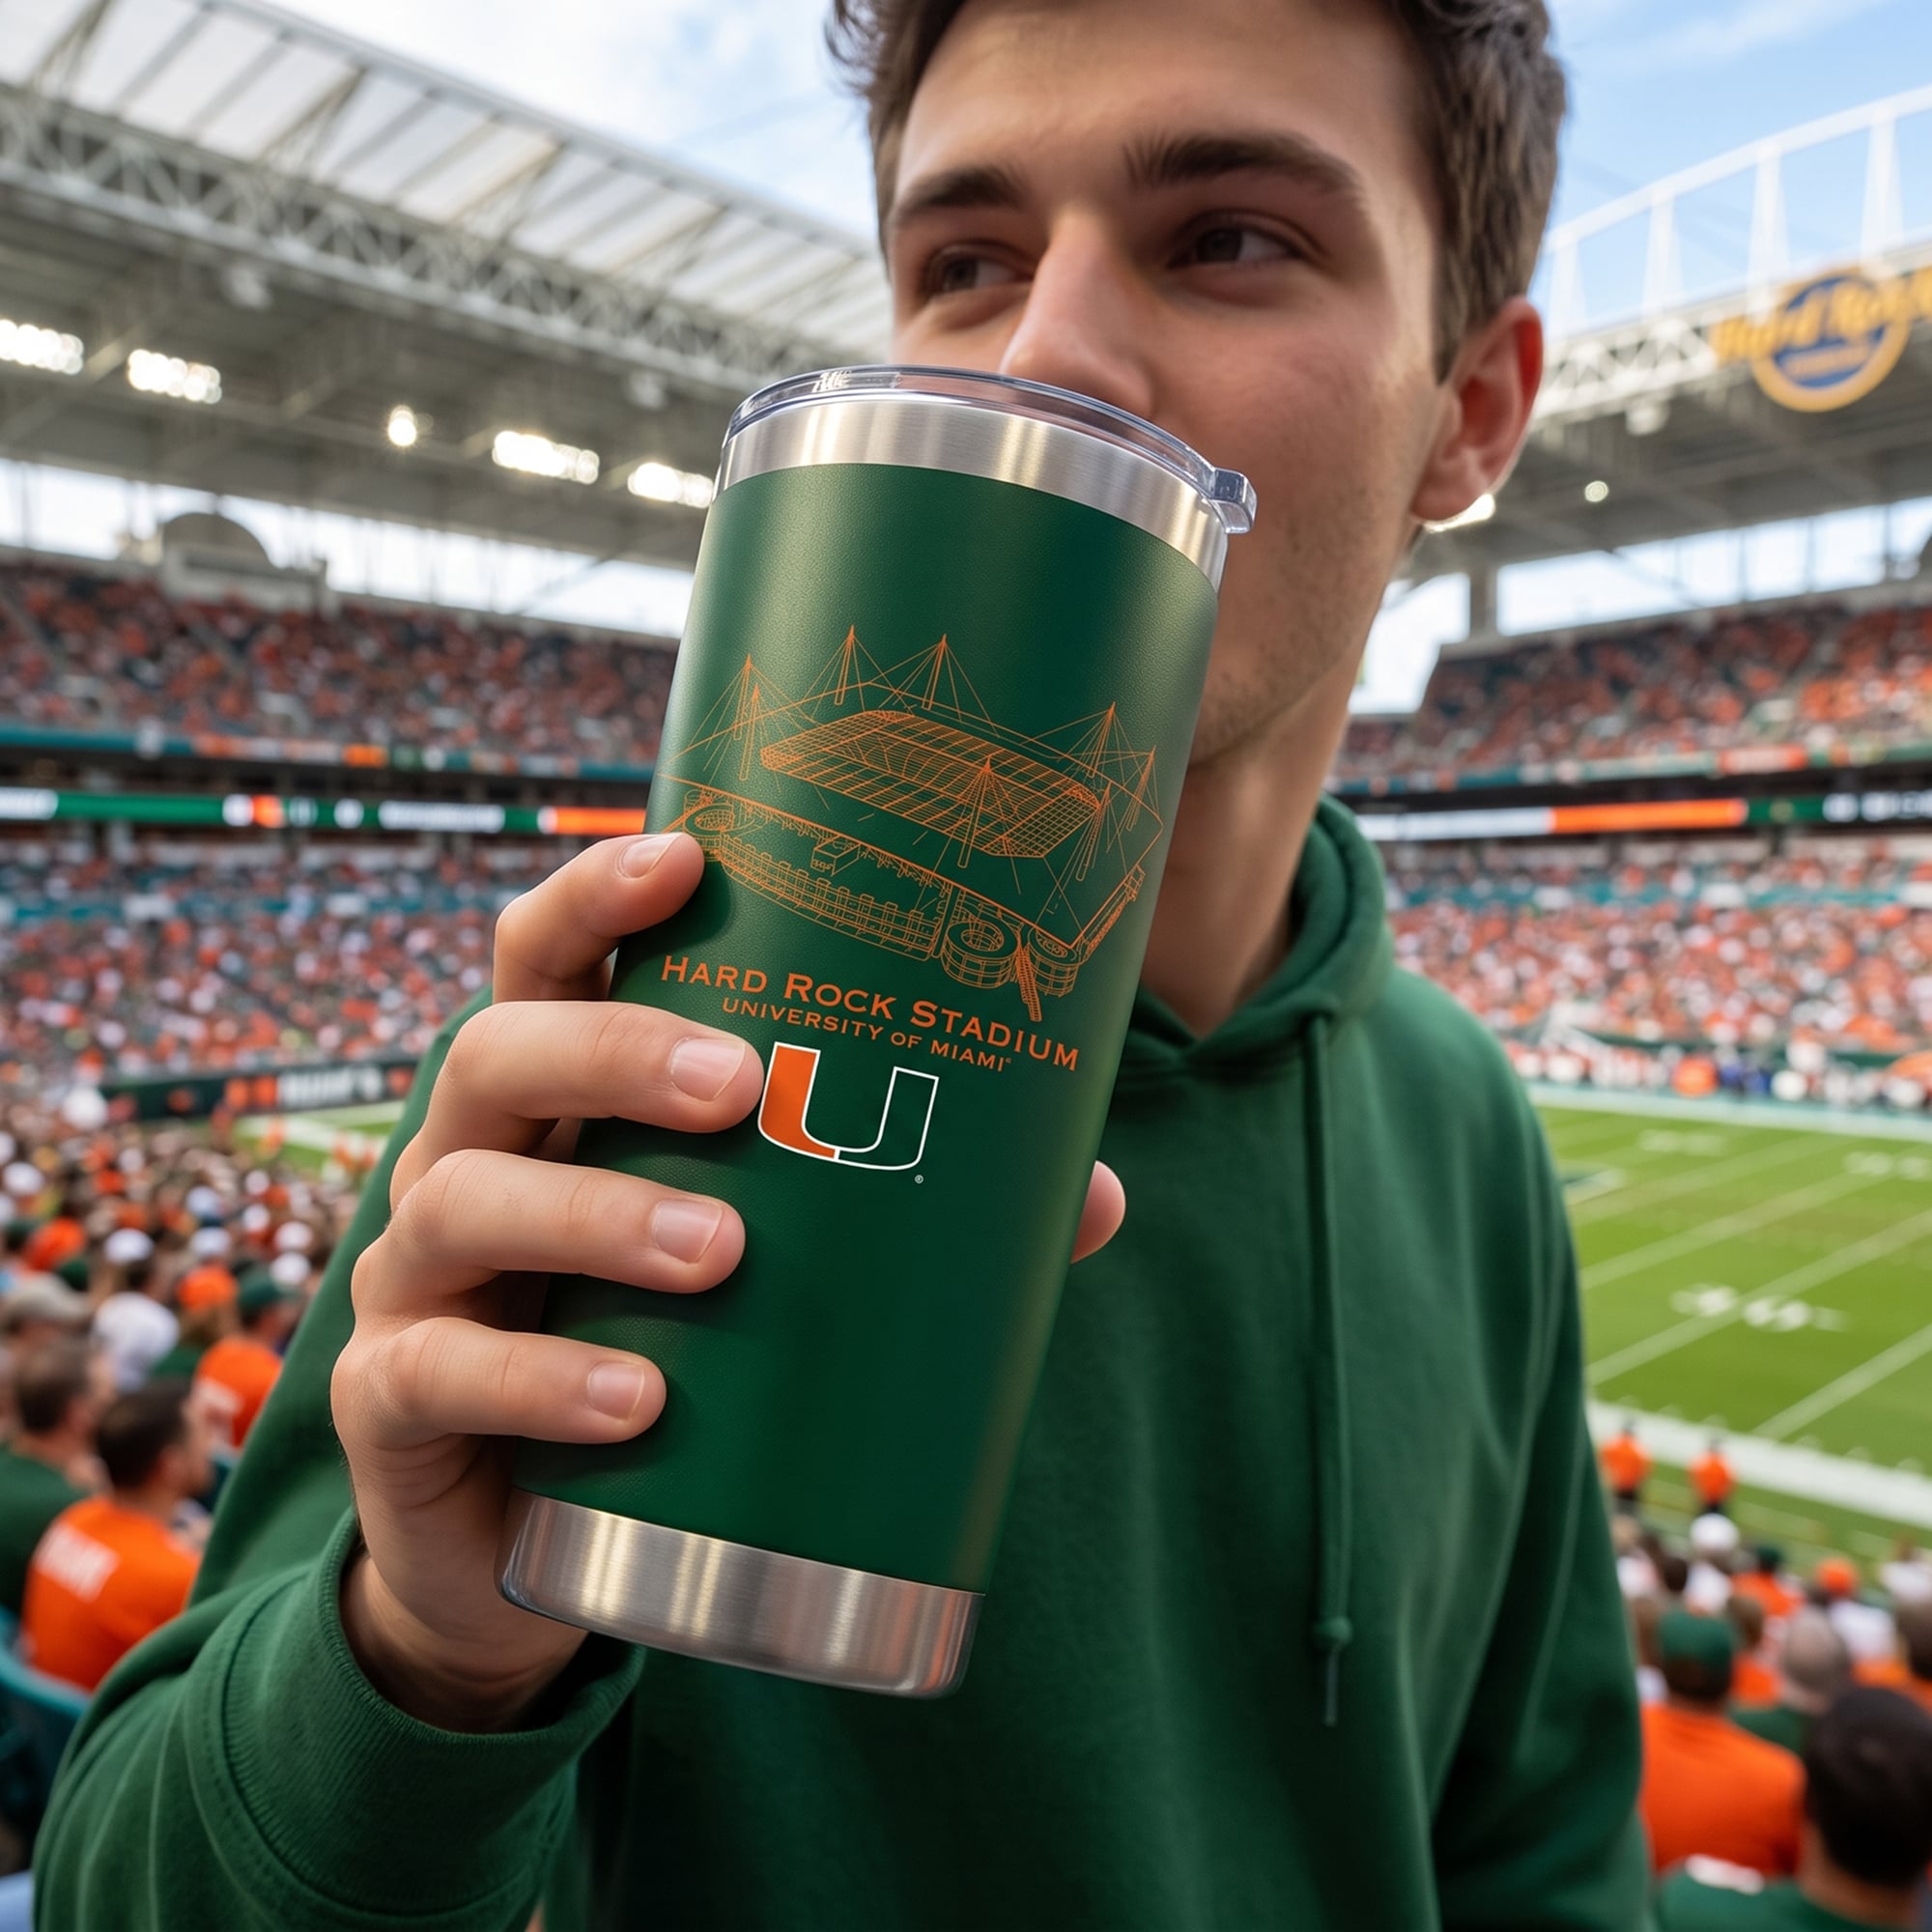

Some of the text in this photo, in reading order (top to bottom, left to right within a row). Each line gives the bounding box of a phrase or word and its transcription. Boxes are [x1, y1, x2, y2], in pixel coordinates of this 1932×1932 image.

[661, 954, 1079, 1071] HARD ROCK STADIUM
[723, 997, 884, 1041] UNIVERSITY
[890, 1032, 923, 1049] OF
[757, 1041, 940, 1171] U
